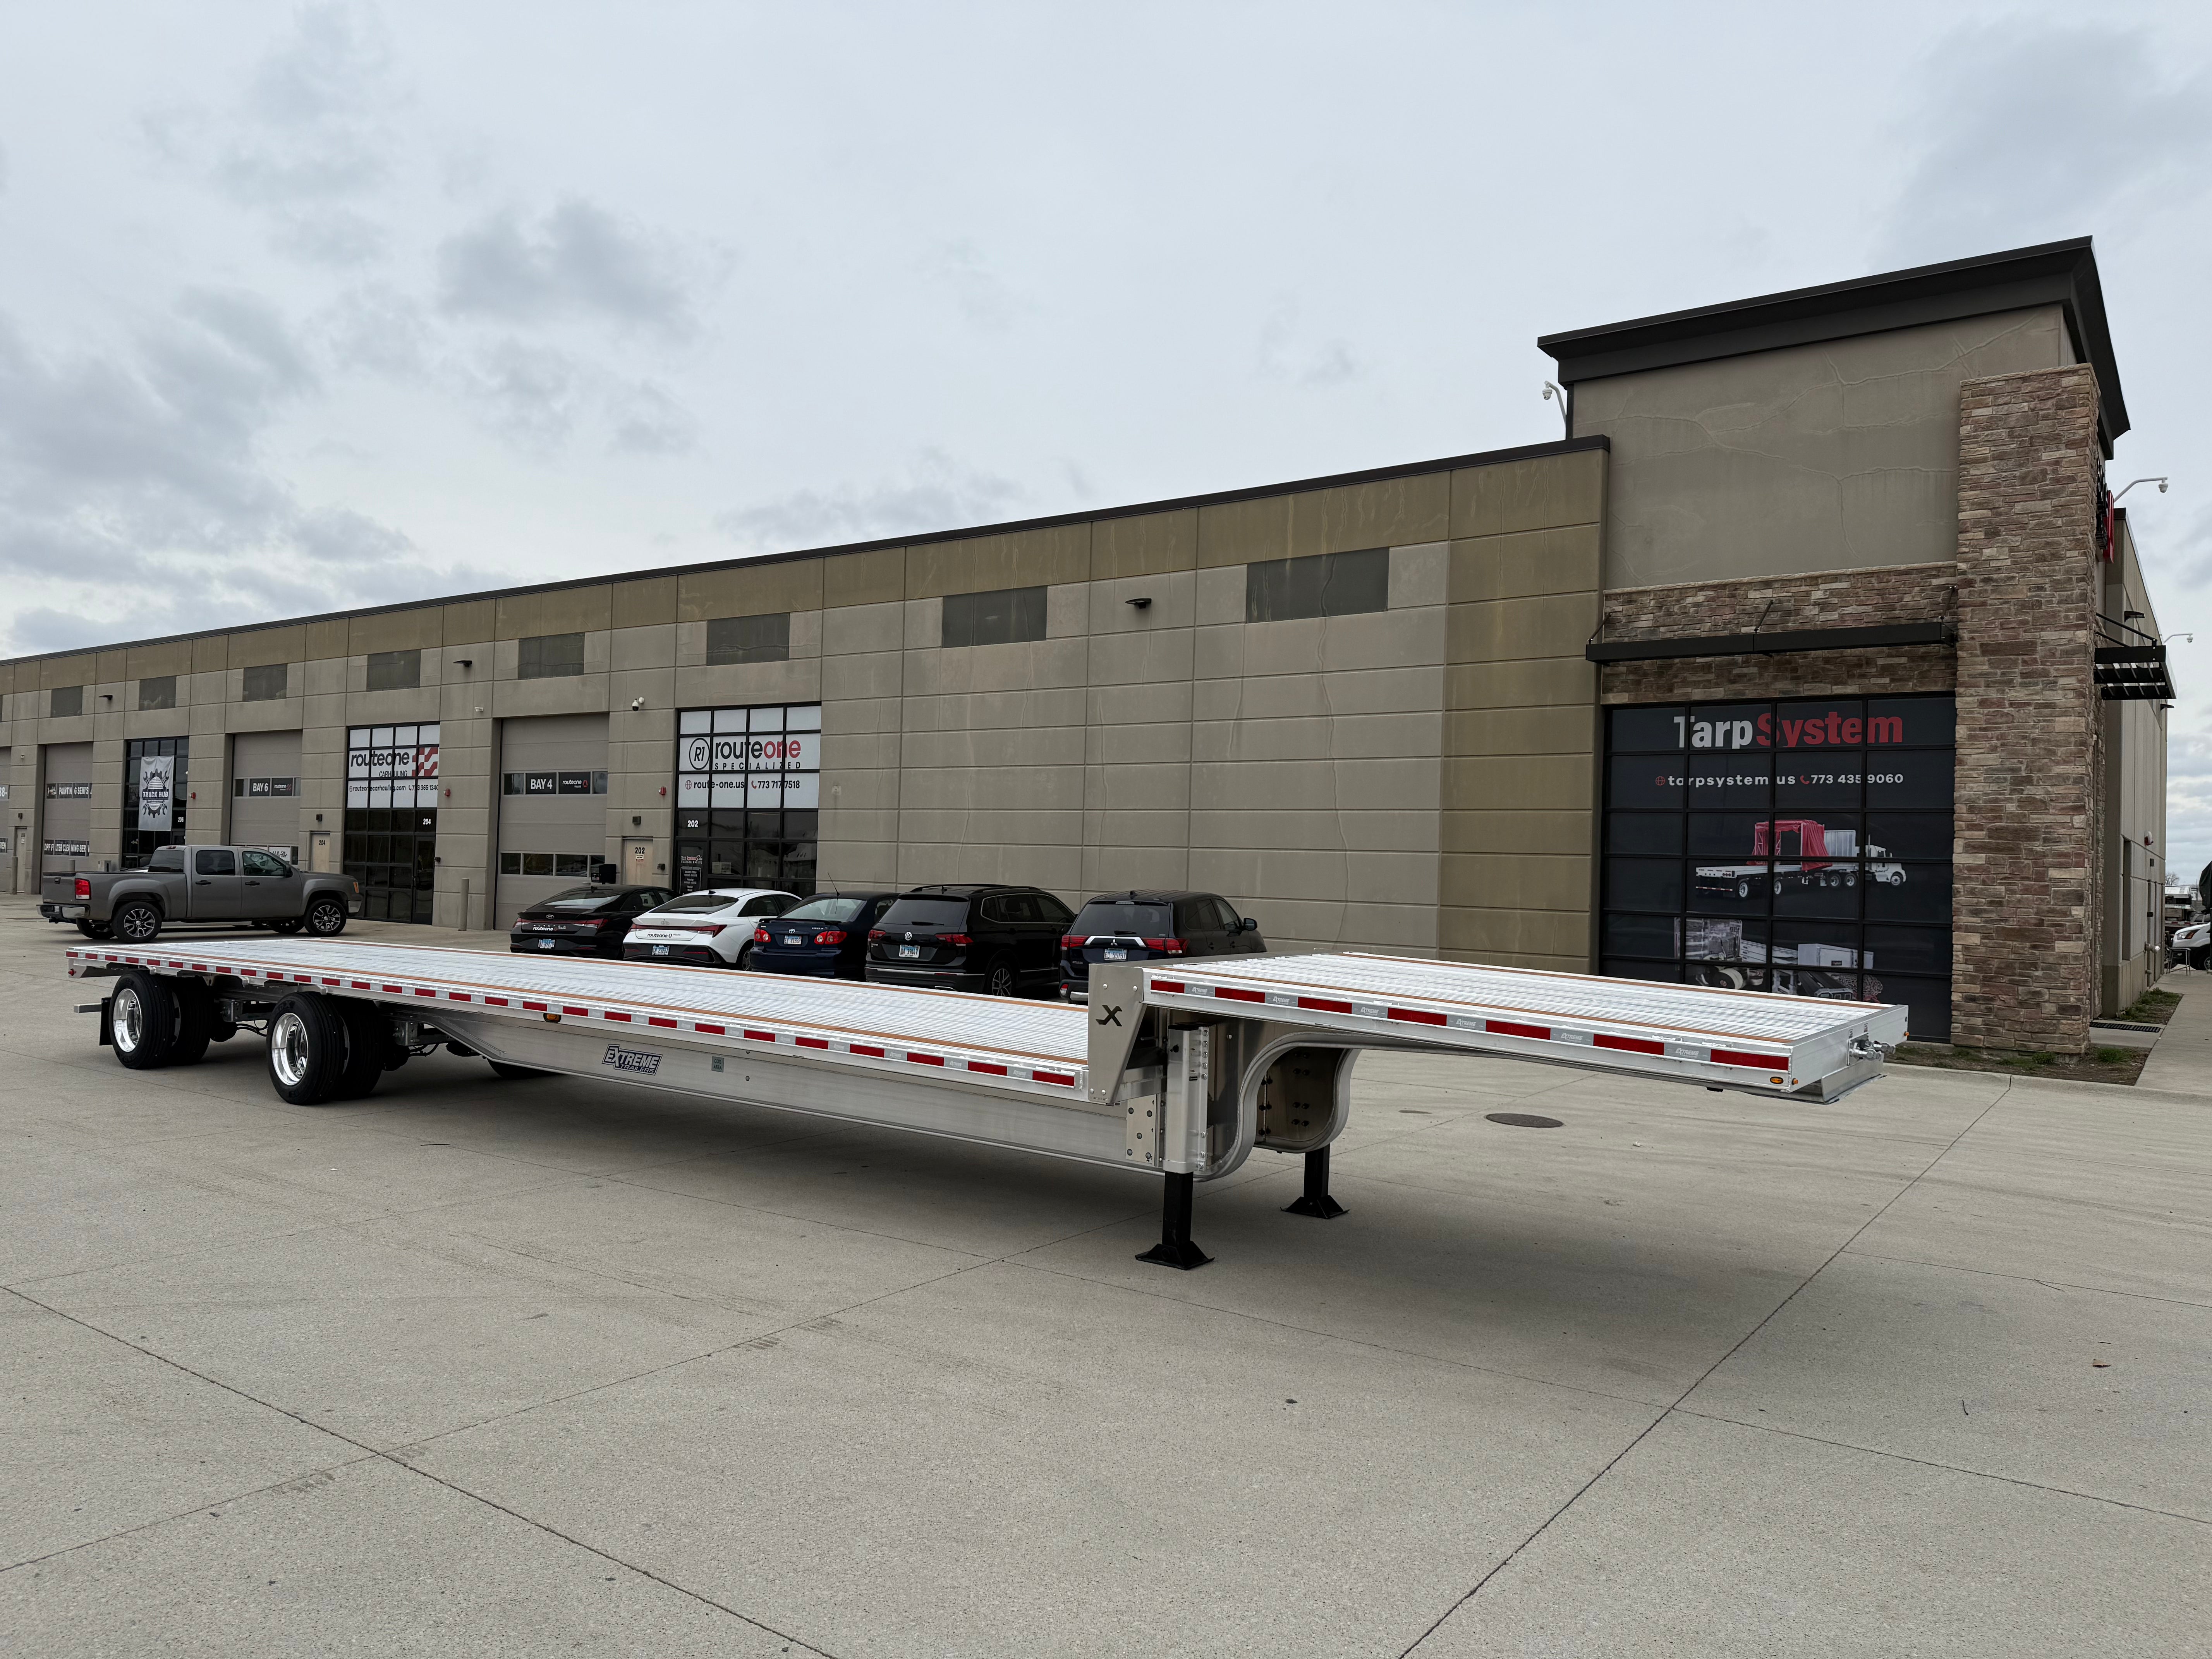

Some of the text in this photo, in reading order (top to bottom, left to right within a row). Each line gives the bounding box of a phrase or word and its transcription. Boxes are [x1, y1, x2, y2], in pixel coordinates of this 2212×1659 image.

[1674, 712, 1902, 749] TarpSystem
[1811, 774, 1903, 783] 773 435 9060
[253, 783, 268, 792] BAY 6
[531, 779, 552, 789] BAY 4
[758, 781, 769, 789] 773
[605, 1047, 659, 1069] EXTREME
[620, 1065, 654, 1073] TRAILERS
